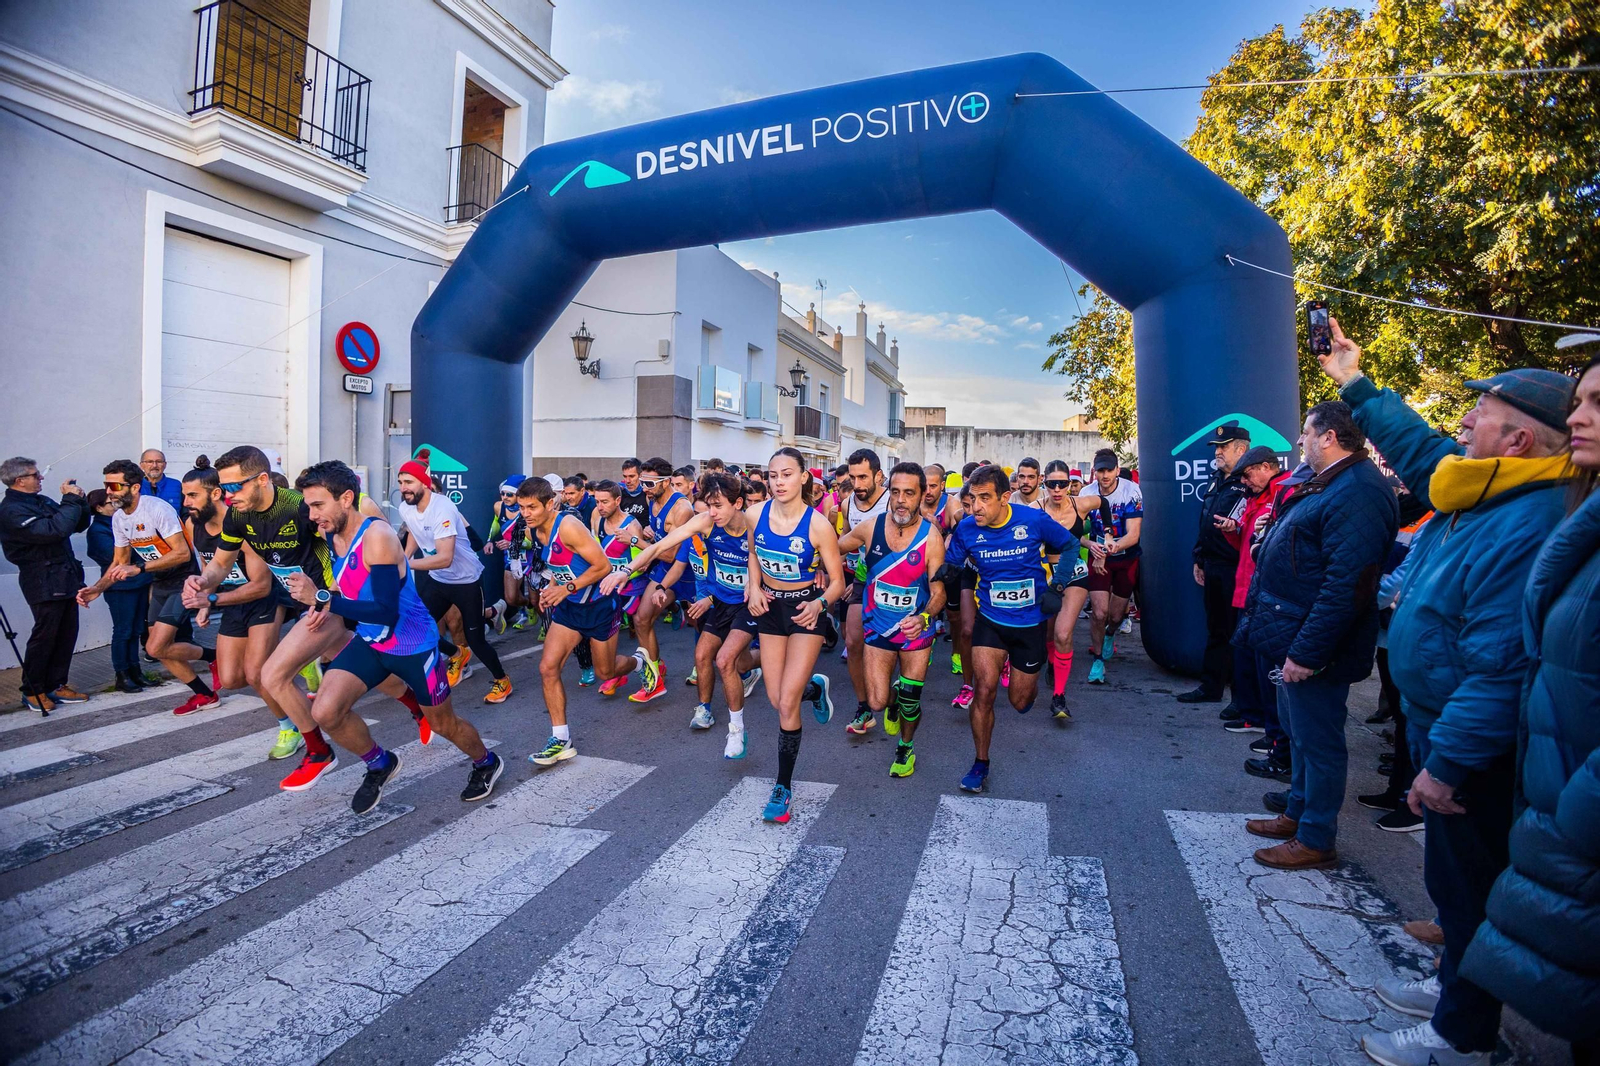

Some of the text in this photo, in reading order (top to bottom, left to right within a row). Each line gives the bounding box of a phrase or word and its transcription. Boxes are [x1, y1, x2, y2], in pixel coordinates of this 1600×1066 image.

[636, 92, 990, 180] DESNIVEL POSITIVO
[979, 546, 1028, 558] Tirabuzón
[761, 558, 793, 573] 311
[719, 571, 744, 584] 141
[784, 589, 810, 599] PRO
[881, 592, 912, 606] 119
[996, 589, 1030, 601] 434
